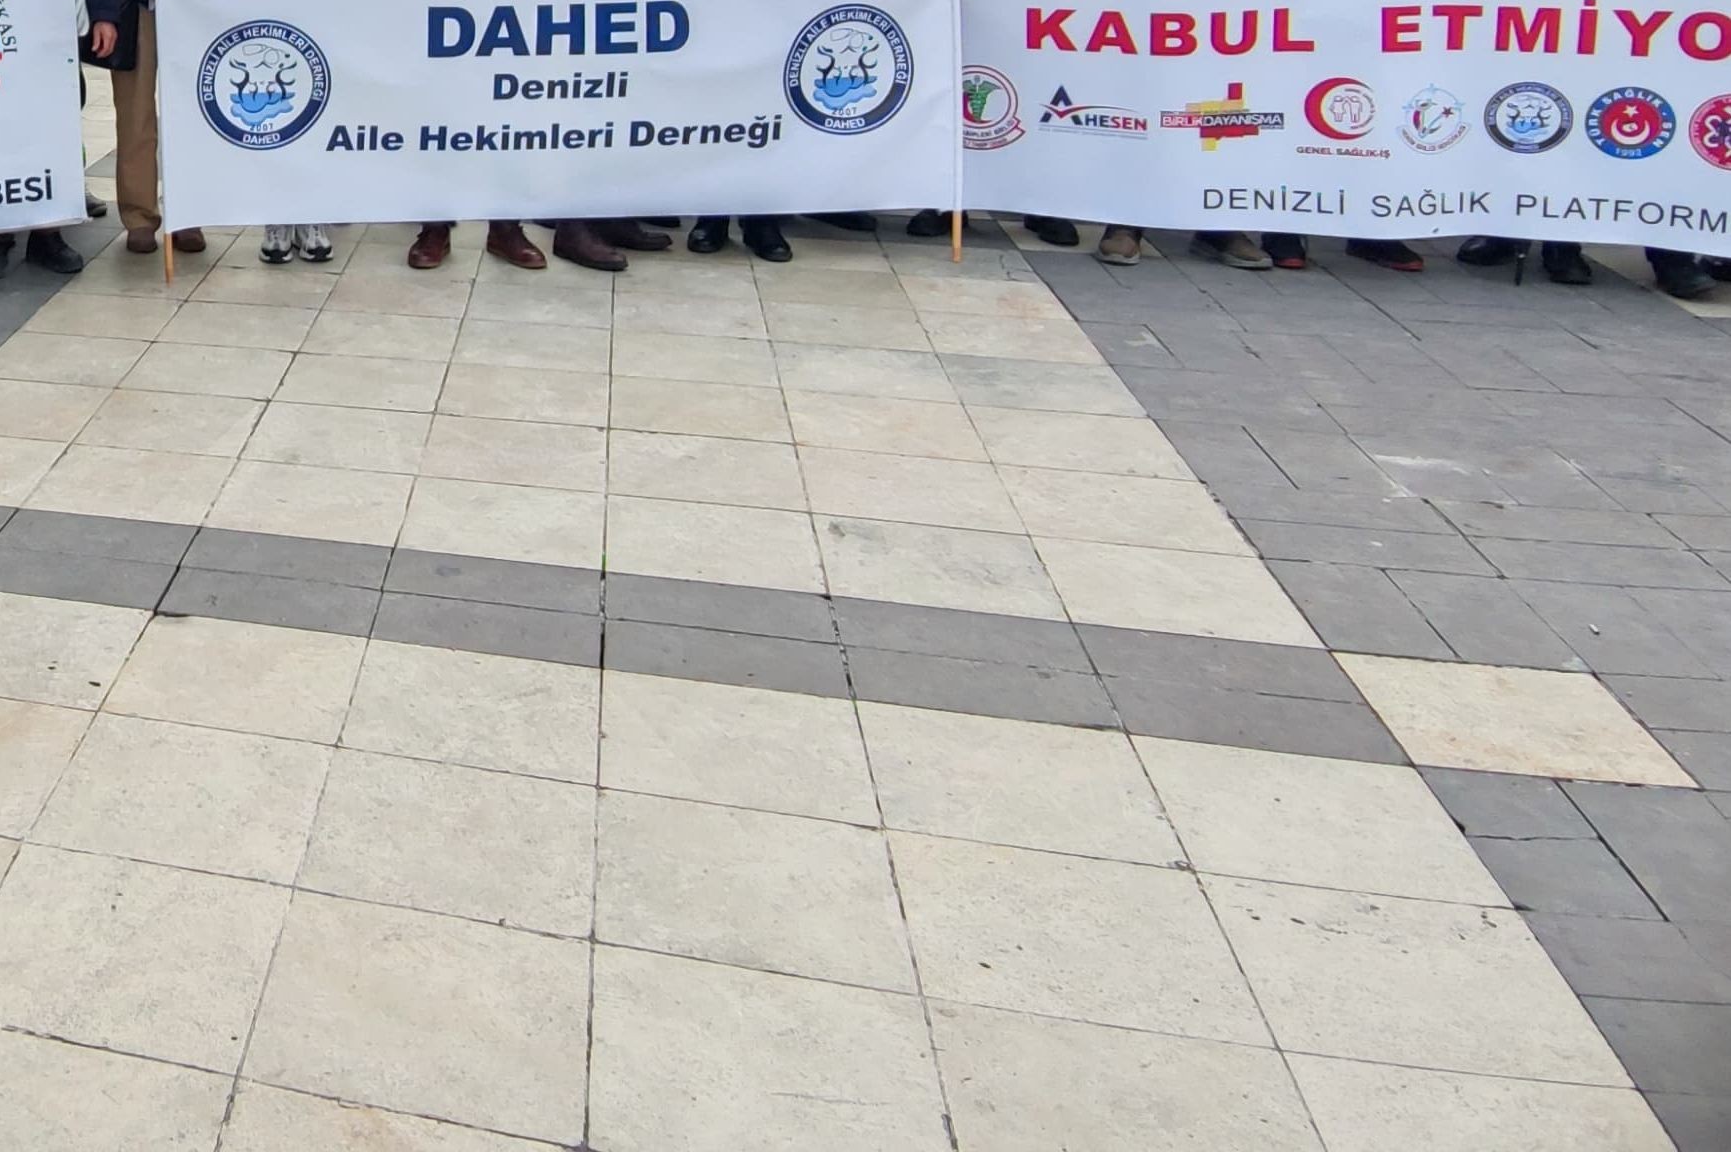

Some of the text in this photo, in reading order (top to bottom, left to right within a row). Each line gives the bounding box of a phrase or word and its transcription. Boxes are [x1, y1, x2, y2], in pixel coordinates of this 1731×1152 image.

[427, 0, 690, 58] DAHED
[790, 38, 809, 87] DENİZLİ
[830, 9, 891, 33] HEKİMLERİ
[1026, 7, 1315, 57] KABUL
[203, 50, 220, 102] DENİZLİ
[242, 24, 308, 52] HEKİMLERİ
[492, 71, 629, 101] Denizli
[242, 132, 281, 145] DAHED
[326, 114, 783, 153] Aile Hekimleri Derneği
[824, 117, 866, 129] DAHED
[1203, 186, 1729, 234] DENİZLİ SAĞLIK PLATFORM
